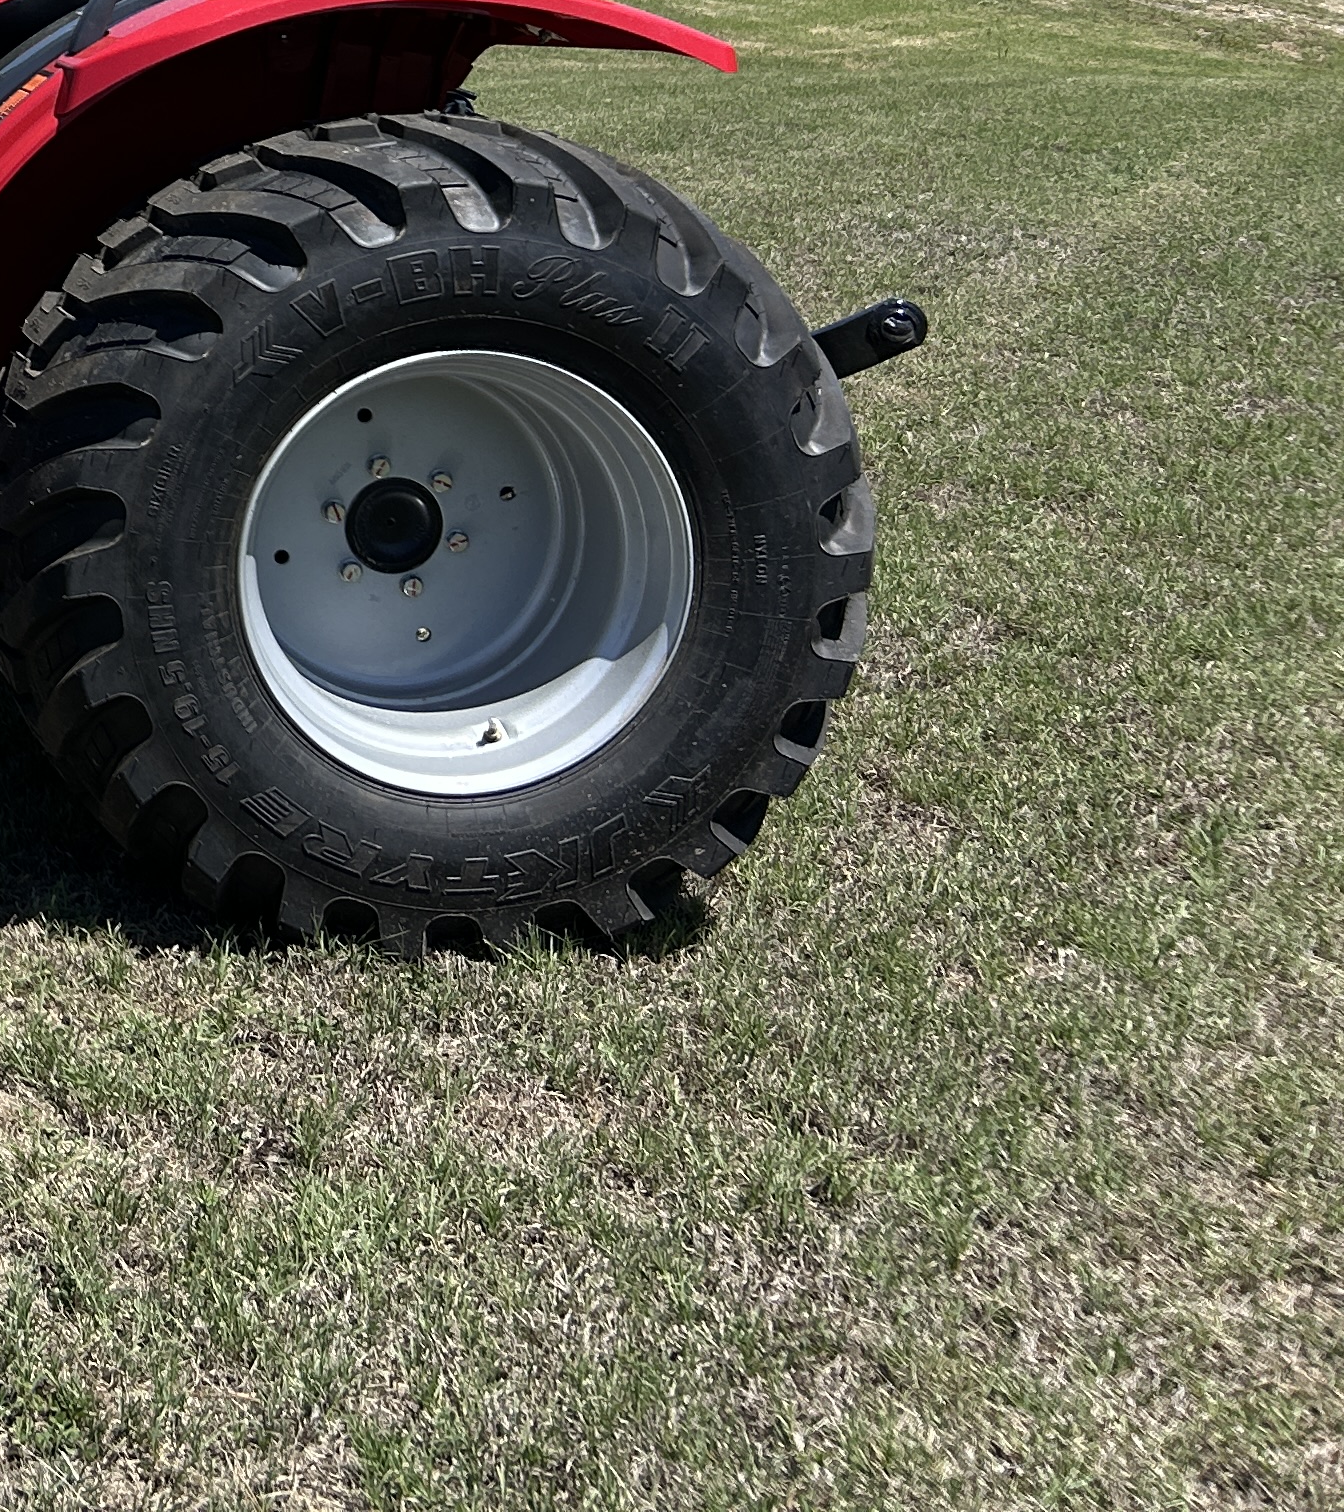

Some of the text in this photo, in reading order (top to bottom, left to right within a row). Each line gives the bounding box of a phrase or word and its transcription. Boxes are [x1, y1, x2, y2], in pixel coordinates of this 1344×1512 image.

[289, 244, 502, 338] V-BH
[511, 254, 643, 327] Plus
[145, 579, 182, 655] NHS
[158, 659, 242, 788] 15-19.5
